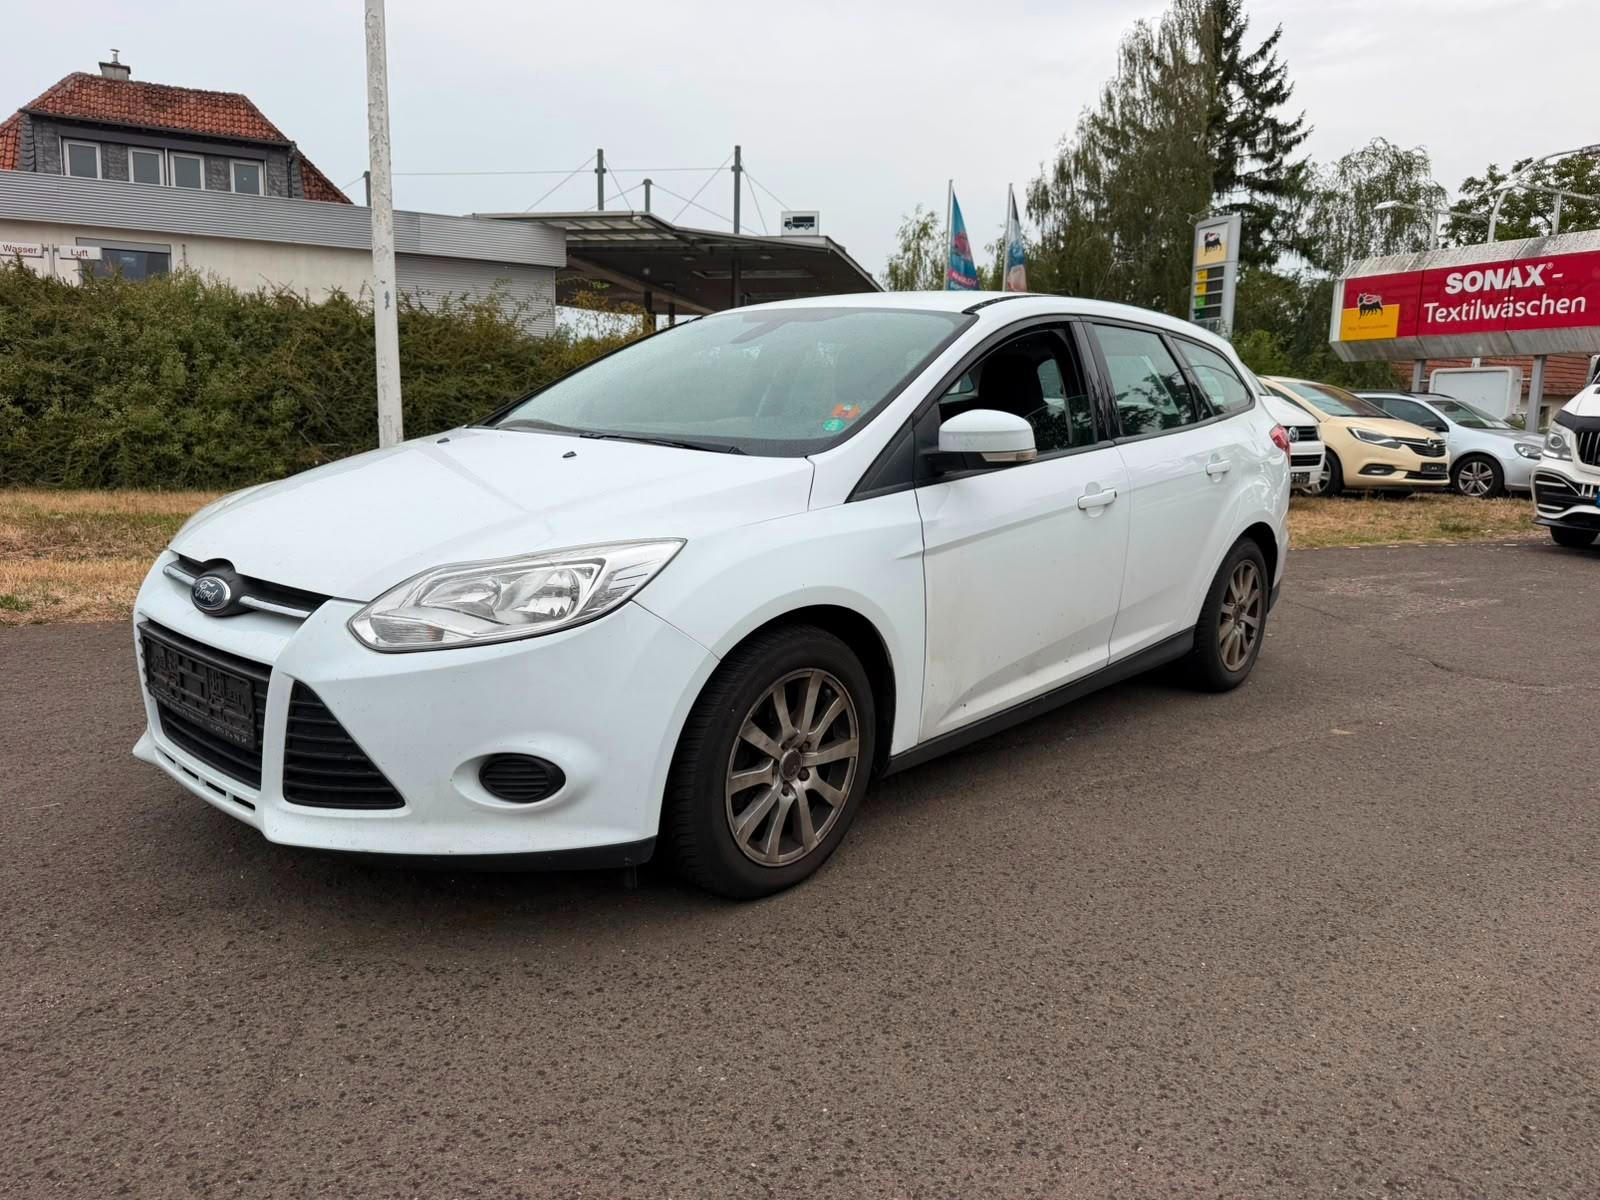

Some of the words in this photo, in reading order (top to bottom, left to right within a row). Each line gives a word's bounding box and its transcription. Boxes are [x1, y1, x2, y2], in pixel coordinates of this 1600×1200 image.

[2, 243, 38, 255] Wasser
[70, 248, 89, 258] Luft
[1423, 293, 1587, 324] Textilwäschen
[198, 580, 219, 603] Ford
